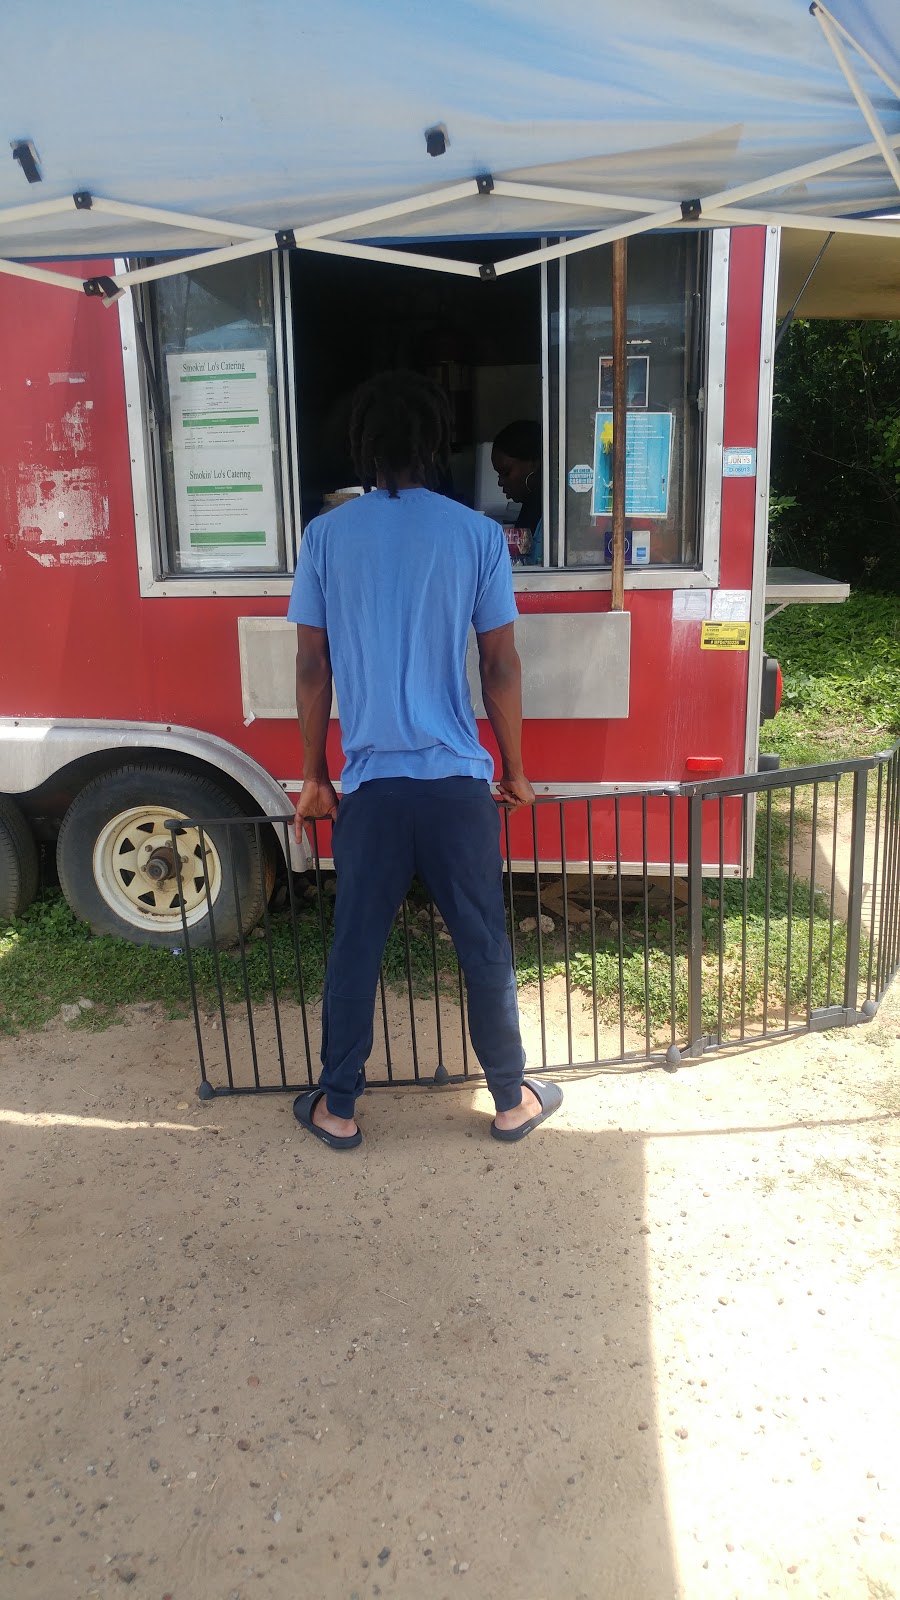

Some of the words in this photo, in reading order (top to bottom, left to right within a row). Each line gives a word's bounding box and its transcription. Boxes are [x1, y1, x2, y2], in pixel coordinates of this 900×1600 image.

[182, 362, 206, 373] Smokin'
[207, 362, 220, 372] Lo's
[220, 360, 246, 371] Catering
[189, 470, 213, 480] Smokin'
[213, 469, 226, 479] Lo's
[226, 468, 252, 480] Catering
